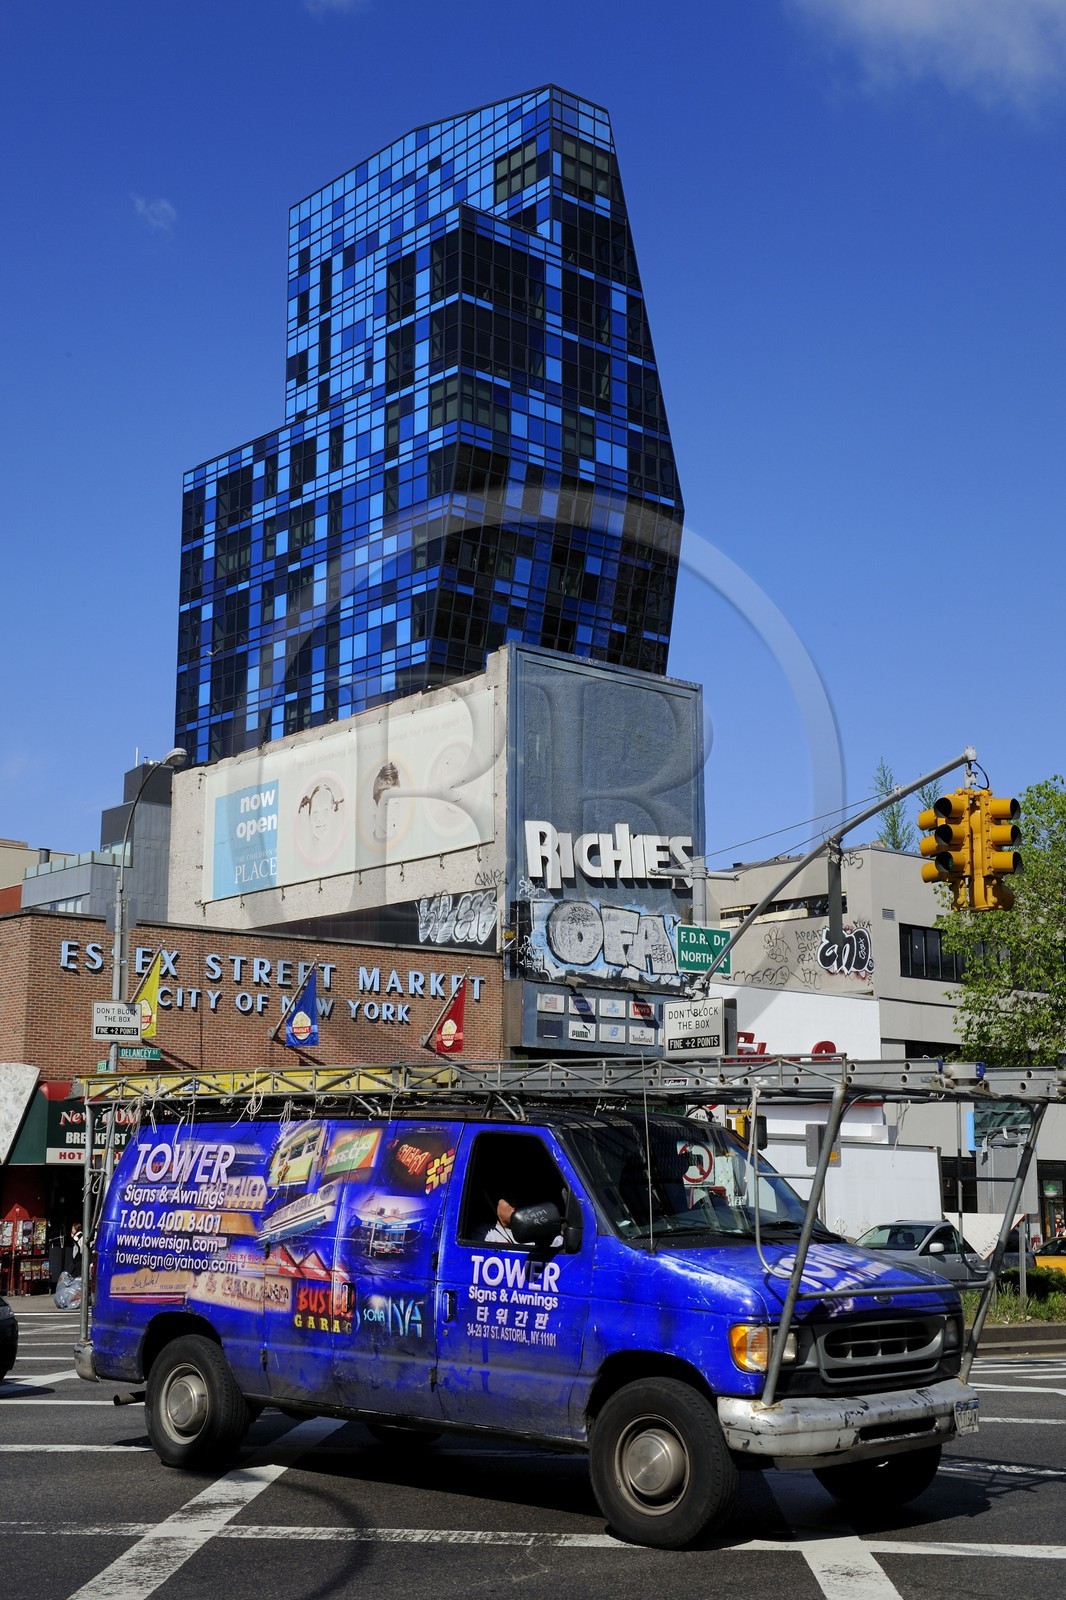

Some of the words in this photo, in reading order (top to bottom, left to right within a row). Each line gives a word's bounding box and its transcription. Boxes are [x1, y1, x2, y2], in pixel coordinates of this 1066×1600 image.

[240, 789, 275, 813] now
[236, 814, 277, 842] open
[524, 820, 693, 890] RICHIES
[234, 857, 277, 884] PLACE
[680, 931, 709, 946] F.D.R.
[713, 935, 727, 947] Dr
[681, 950, 713, 964] NORTH
[157, 986, 221, 1009] CITY
[235, 992, 269, 1013] OF
[281, 995, 334, 1017] NW
[347, 1000, 410, 1023] YORK
[668, 1008, 691, 1020] DON'T
[693, 1006, 719, 1018] BLOCK
[96, 1026, 109, 1034] FINE
[110, 1027, 119, 1035] +2
[678, 1021, 693, 1031] THE
[695, 1019, 710, 1030] BOX
[121, 1047, 152, 1058] DELANCEY
[669, 1038, 684, 1050] FINE
[685, 1038, 696, 1049] +2
[697, 1035, 719, 1048] POINTS
[65, 1132, 127, 1145] BREKFST
[58, 1151, 83, 1160] HOT
[132, 1143, 236, 1184] TOWER
[124, 1184, 156, 1207] Signs
[156, 1185, 169, 1203] &
[170, 1186, 226, 1209] Awnings
[120, 1209, 222, 1234] T.800.400.8401
[116, 1232, 218, 1253] www.towersign.com
[115, 1250, 239, 1273] towersign@yahoo.com
[471, 1254, 560, 1293] TOWER
[468, 1285, 497, 1304] Signs
[499, 1288, 509, 1303] &
[510, 1289, 559, 1311] Awnings
[482, 1324, 490, 1338] 37
[490, 1325, 500, 1340] ST.
